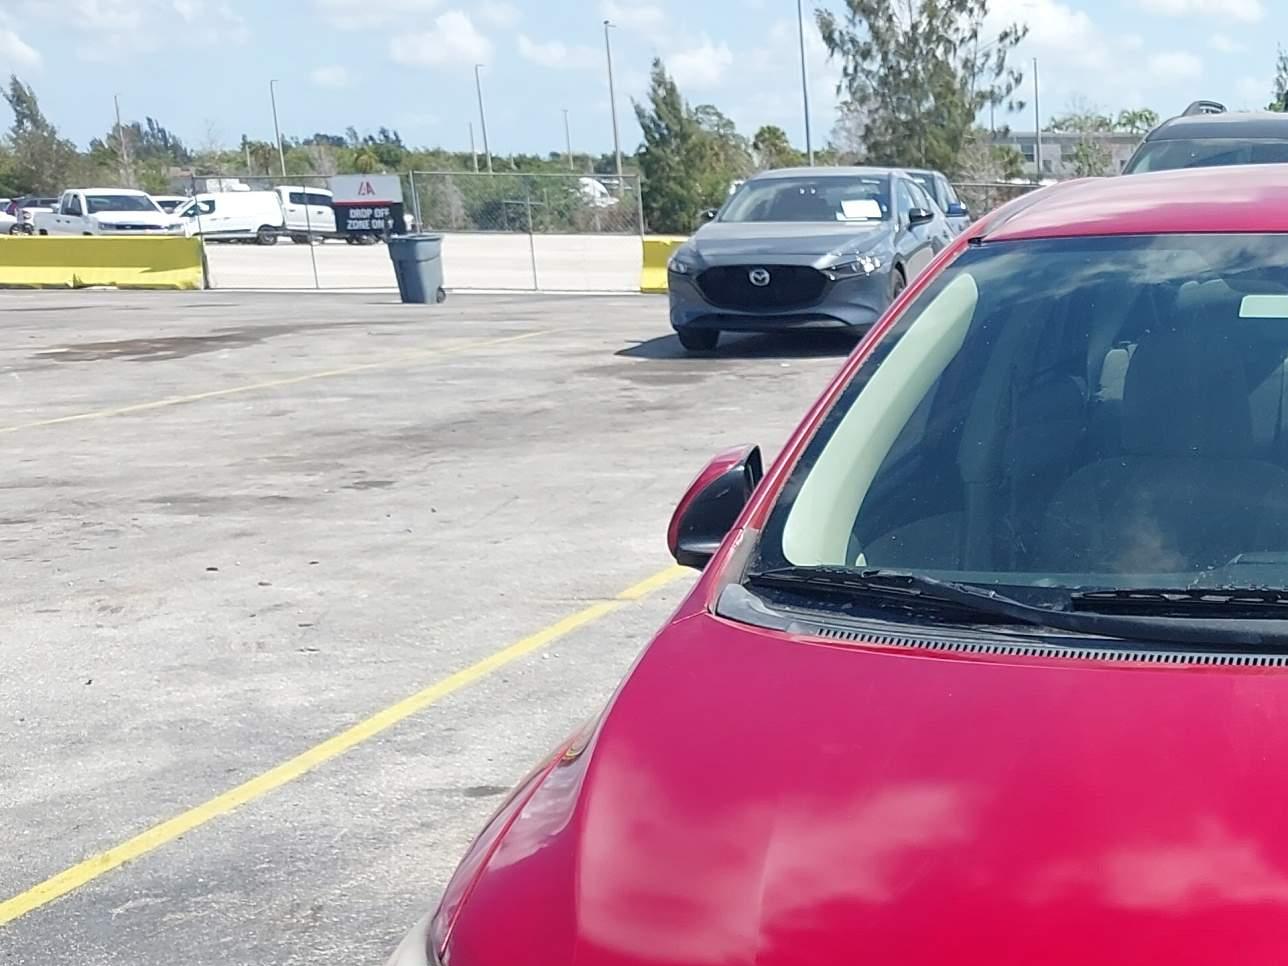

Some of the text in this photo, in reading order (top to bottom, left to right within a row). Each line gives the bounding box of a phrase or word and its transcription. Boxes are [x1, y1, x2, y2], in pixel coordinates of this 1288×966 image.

[349, 208, 390, 218] DROP OFF
[346, 219, 385, 230] ZONE ON
